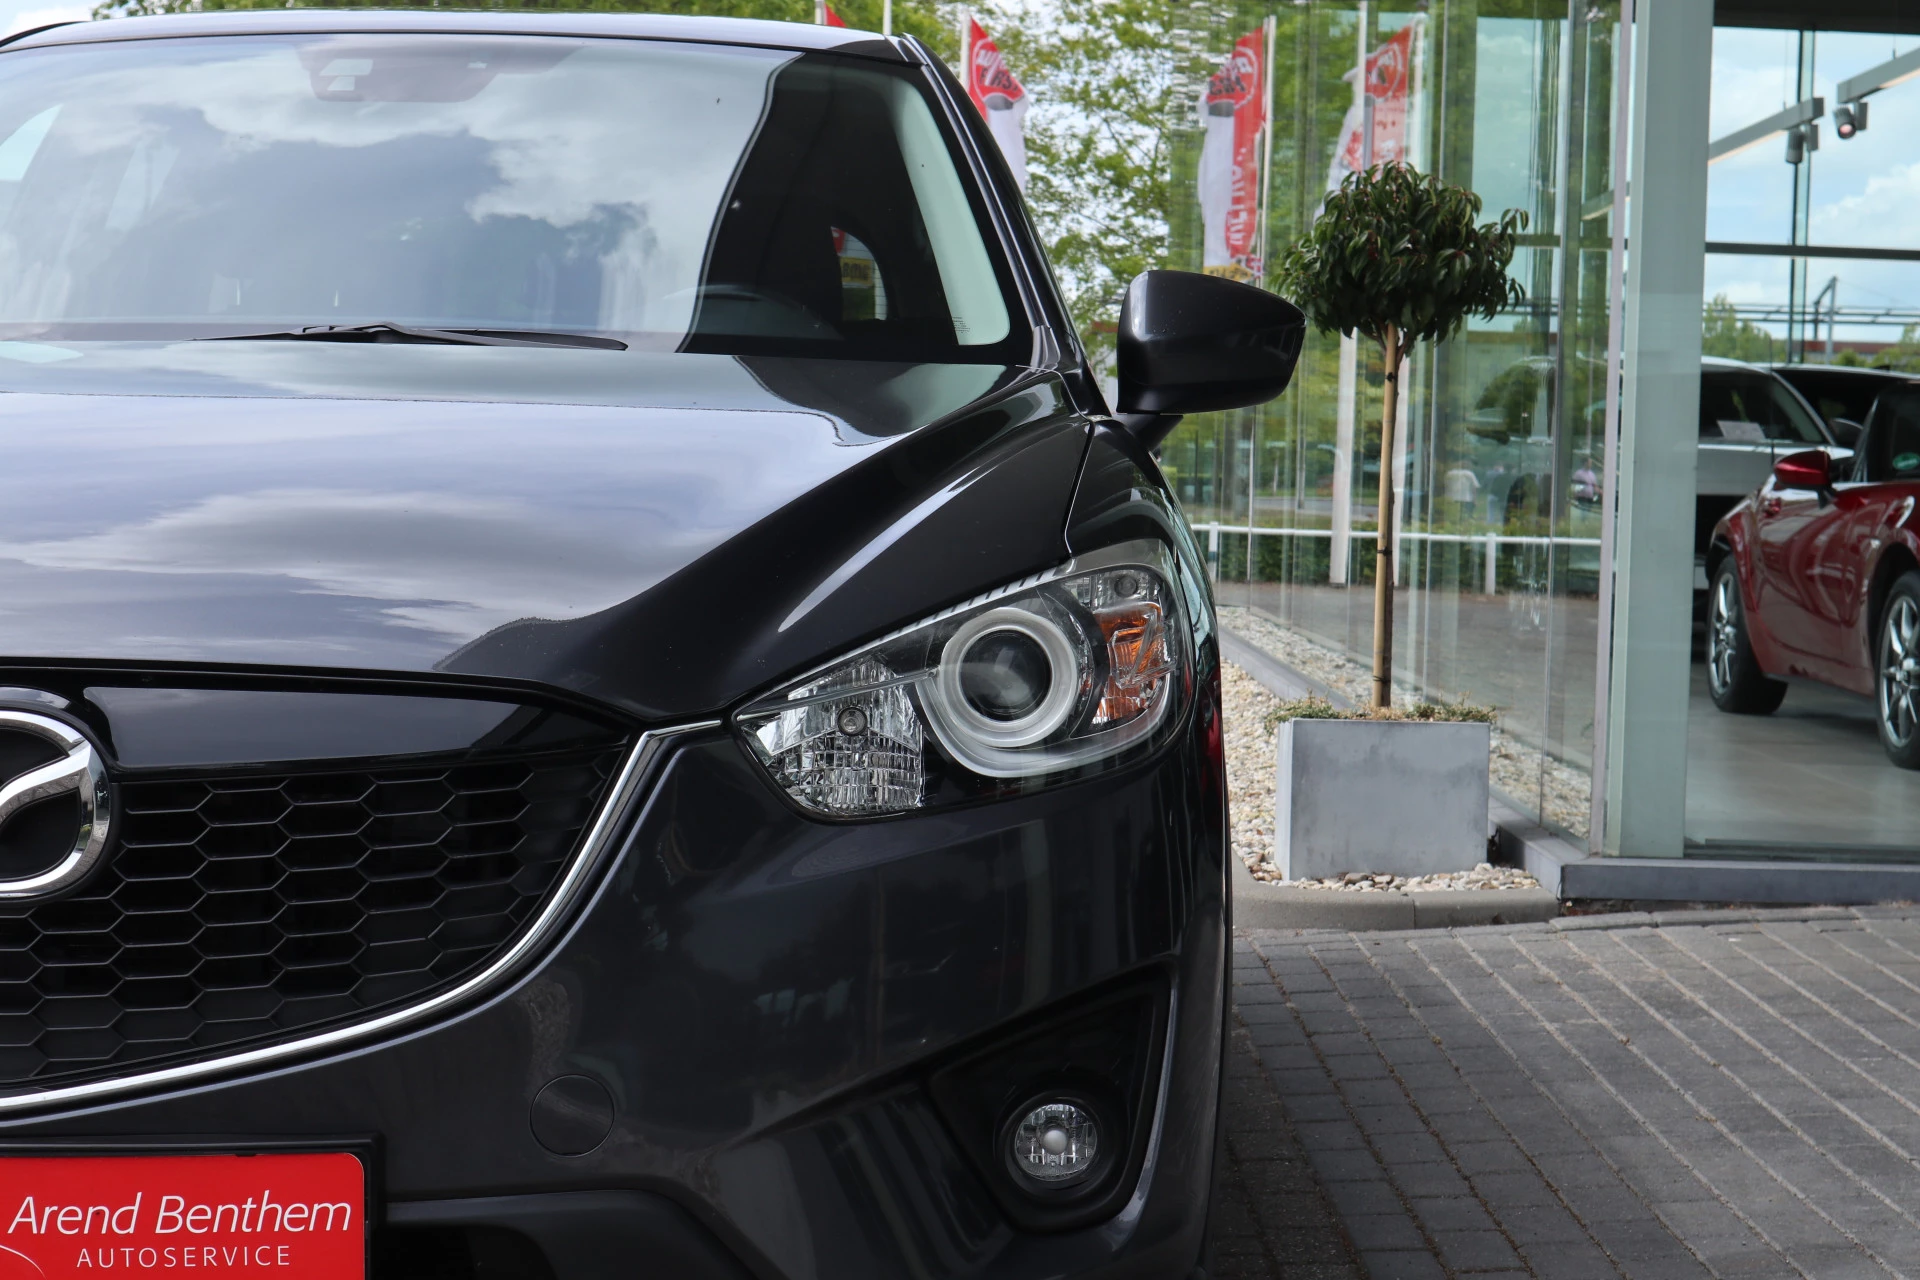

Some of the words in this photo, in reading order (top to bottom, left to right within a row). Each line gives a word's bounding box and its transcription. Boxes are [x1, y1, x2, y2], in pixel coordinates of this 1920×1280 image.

[8, 1192, 142, 1235] Arend
[155, 1190, 352, 1234] Benthem
[76, 1245, 291, 1268] AUTOSERVICE
